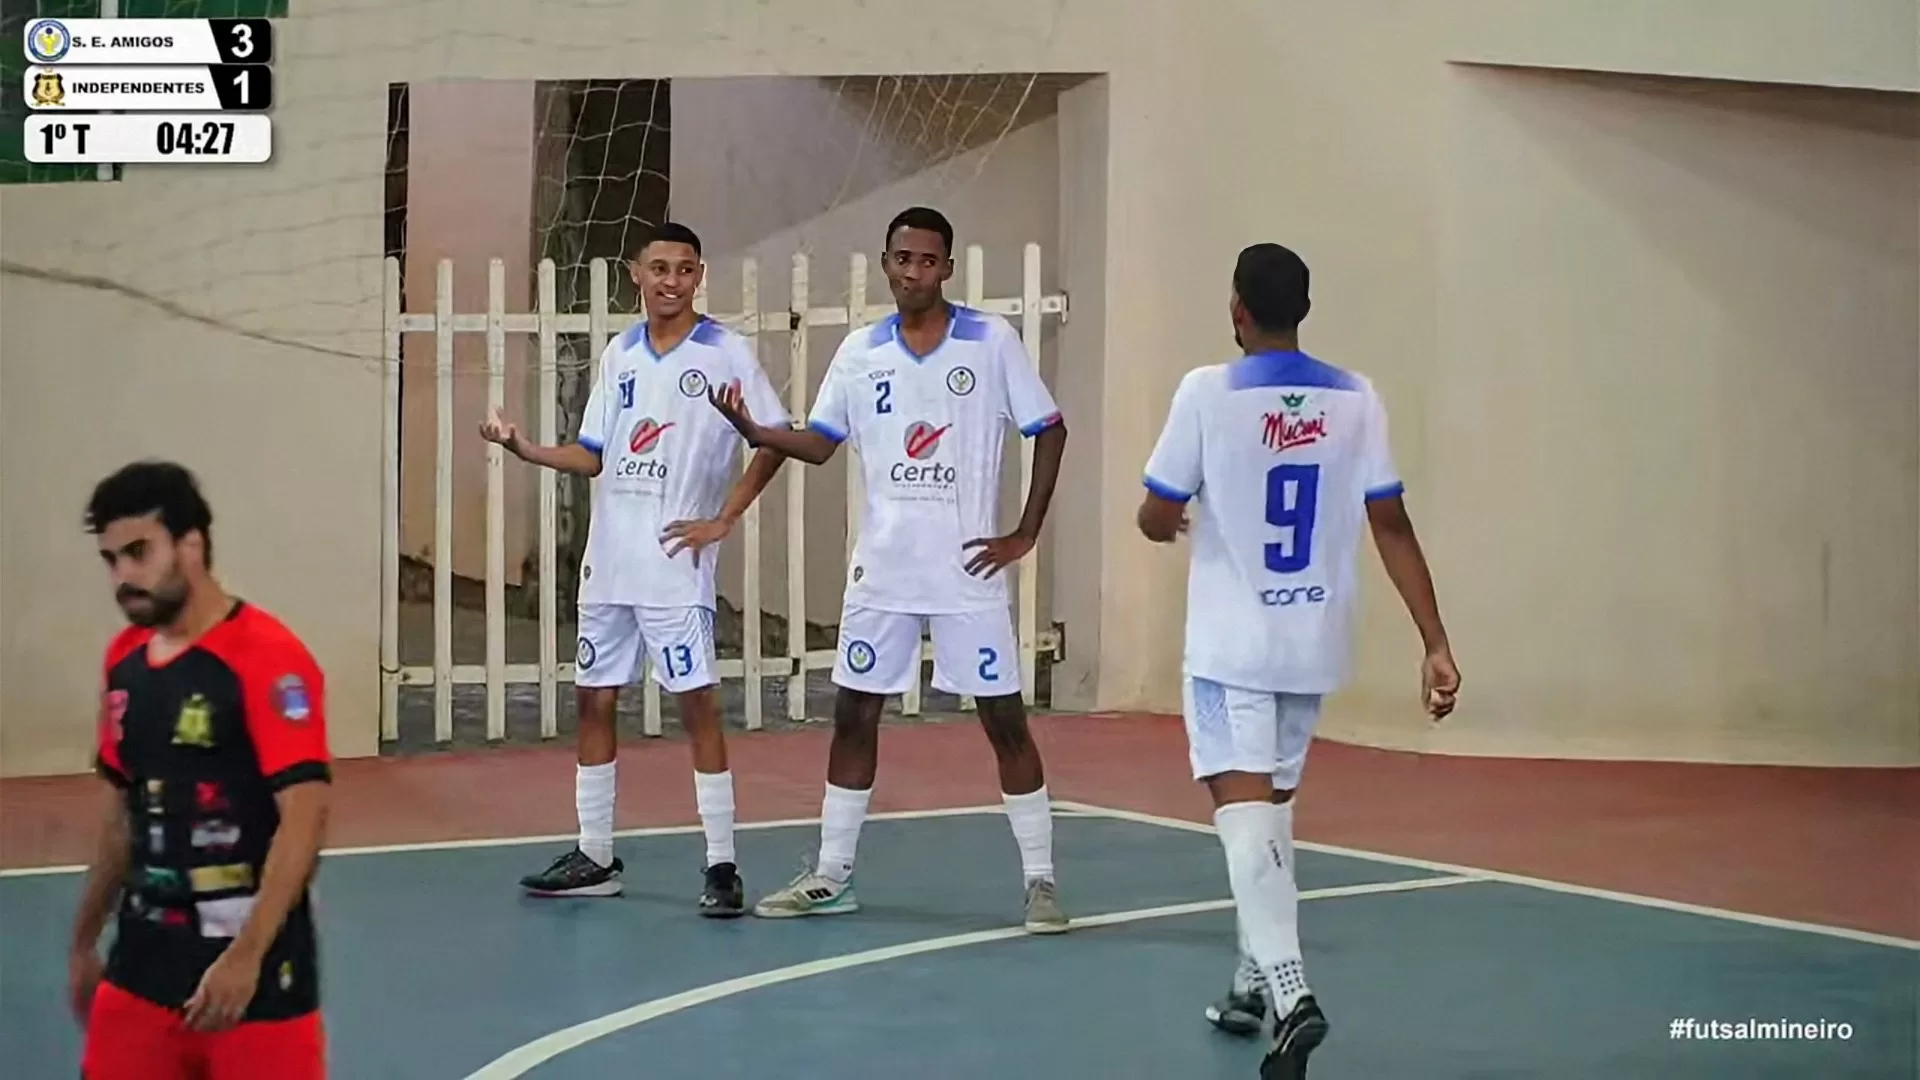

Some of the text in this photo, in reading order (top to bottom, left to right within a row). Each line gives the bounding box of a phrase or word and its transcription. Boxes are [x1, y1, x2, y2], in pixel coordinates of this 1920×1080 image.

[876, 380, 892, 414] 2
[616, 456, 667, 479] Certo
[890, 462, 956, 482] Certo
[1264, 464, 1320, 574] 9
[662, 644, 692, 679] 13
[978, 647, 999, 681] 2
